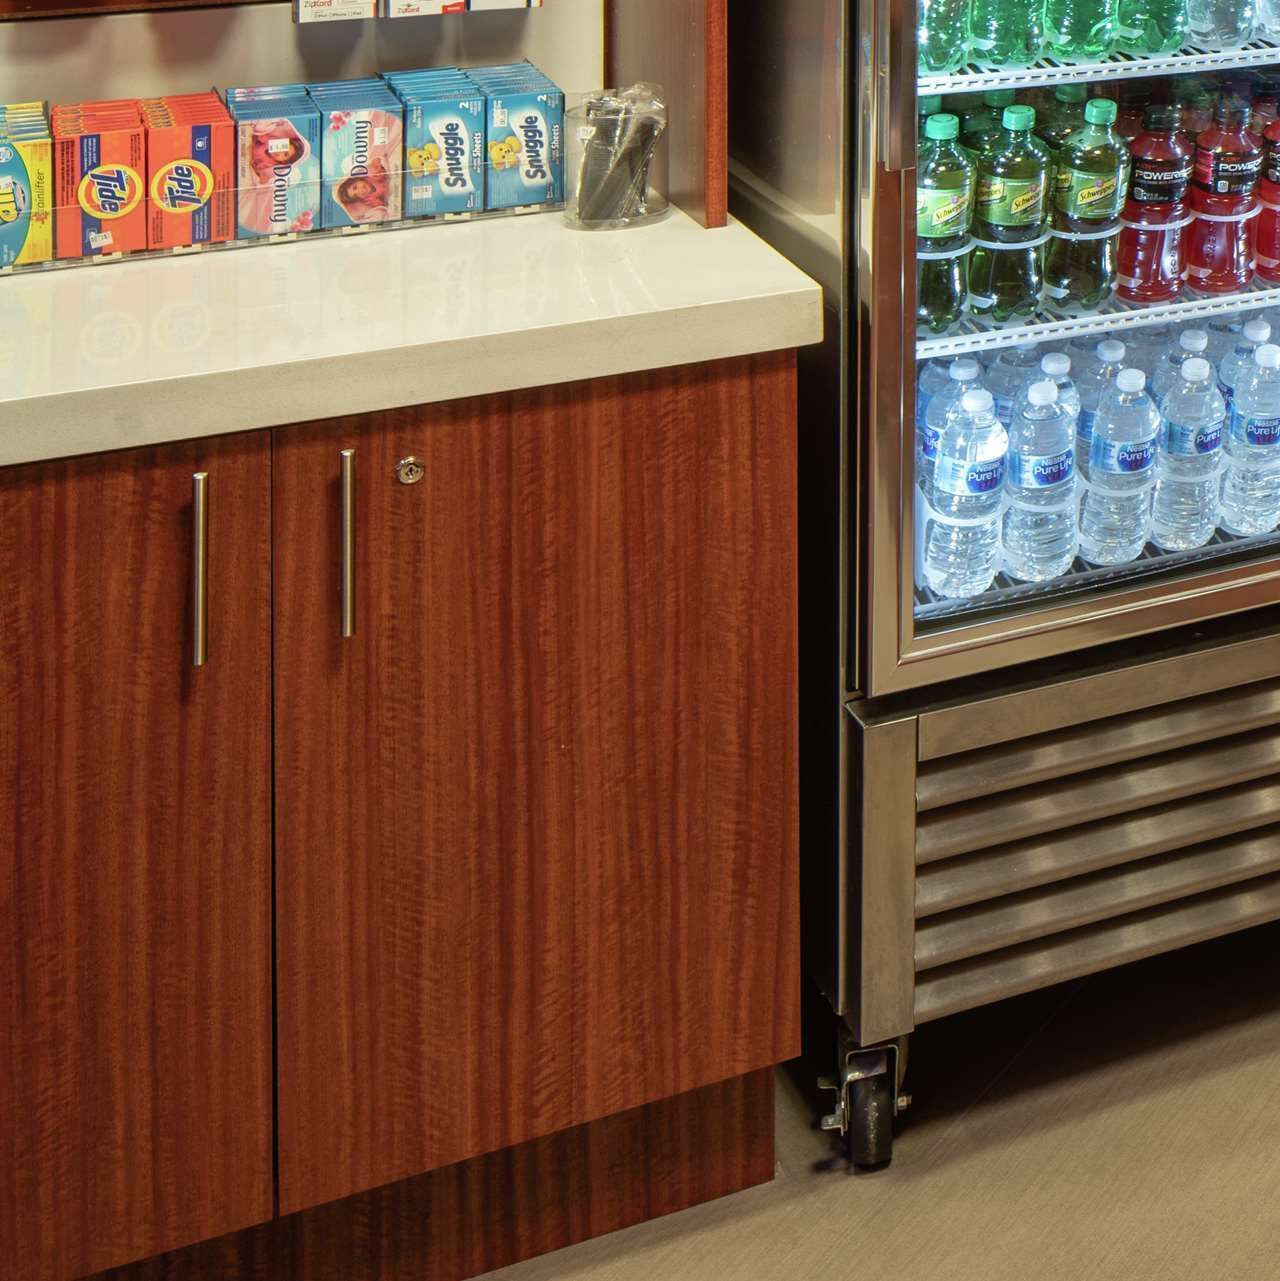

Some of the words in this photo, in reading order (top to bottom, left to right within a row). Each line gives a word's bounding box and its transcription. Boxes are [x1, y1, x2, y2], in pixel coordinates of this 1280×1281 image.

[350, 120, 373, 177] Downy
[440, 122, 467, 188] Snuggle
[525, 115, 547, 180] Snuggle
[89, 169, 129, 213] Tide
[167, 164, 202, 209] Tide
[269, 165, 292, 223] Downy
[1247, 424, 1270, 434] Pure
[1034, 462, 1059, 476] Pure
[1119, 449, 1143, 460] Pure
